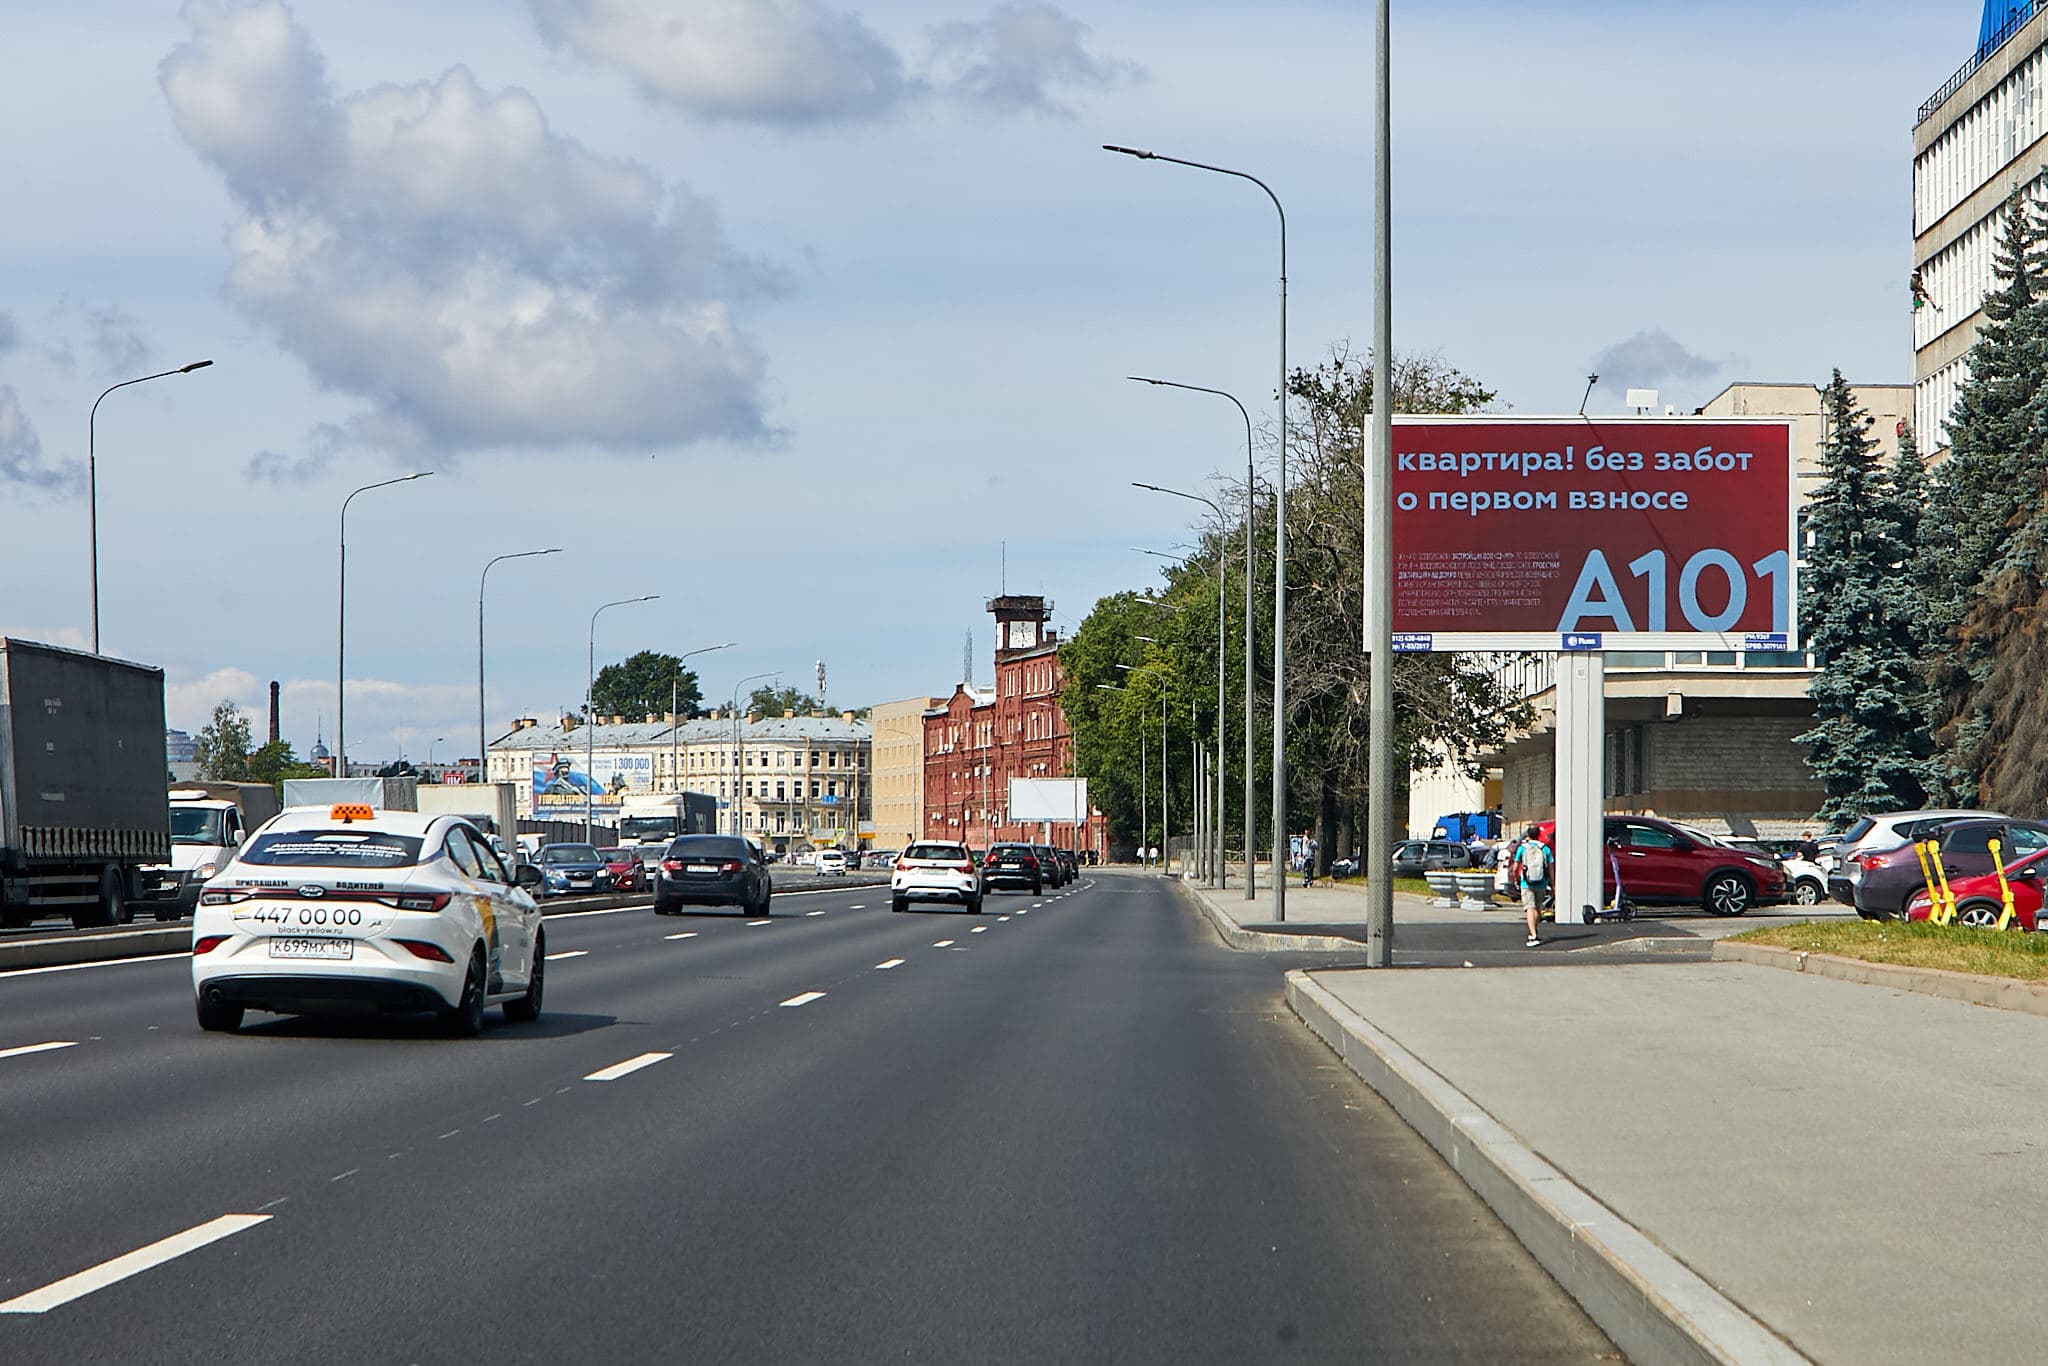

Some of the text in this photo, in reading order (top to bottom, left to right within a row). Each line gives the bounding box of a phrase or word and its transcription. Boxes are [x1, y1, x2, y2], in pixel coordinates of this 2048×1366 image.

[1397, 446, 1753, 478] квартира! без забот
[1397, 491, 1689, 517] о первом взносе
[1555, 548, 1789, 633] А101
[235, 879, 385, 890] ПРИГЛАШАЕМ ВОДИТЕЛЕЙ
[253, 907, 362, 926] 447 00 00
[278, 926, 344, 936] black-yellow.ru
[274, 939, 349, 953] К699МХ 147
